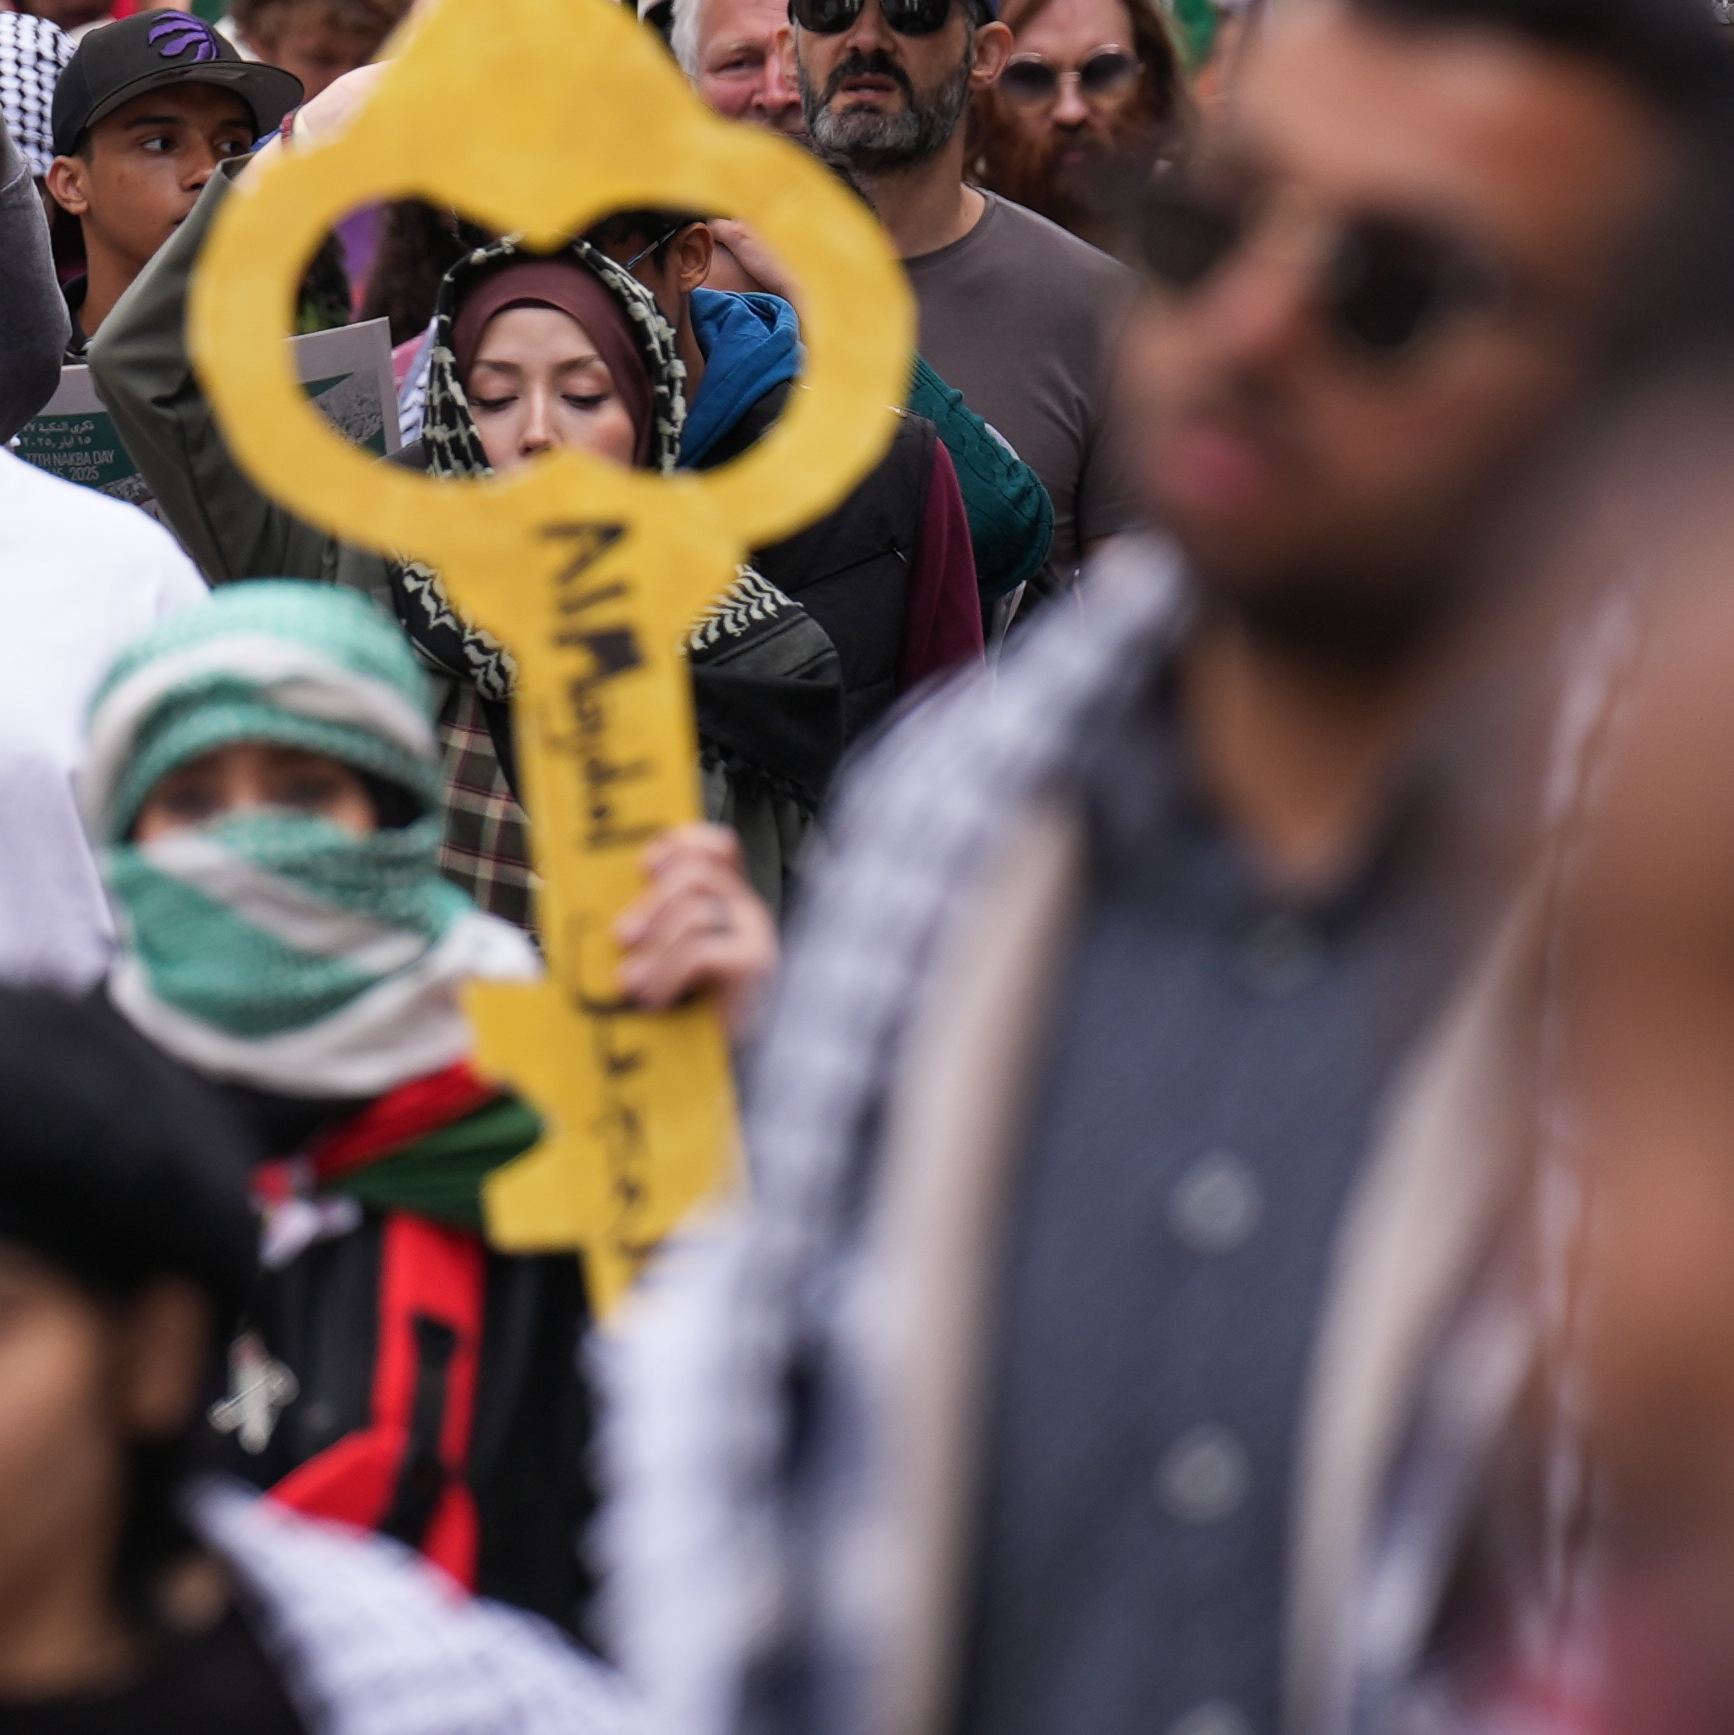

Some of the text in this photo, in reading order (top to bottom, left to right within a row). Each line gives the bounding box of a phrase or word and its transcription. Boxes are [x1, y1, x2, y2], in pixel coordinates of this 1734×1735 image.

[52, 451, 92, 467] NAKBA
[92, 449, 116, 465] DAY
[69, 466, 100, 481] 2025
